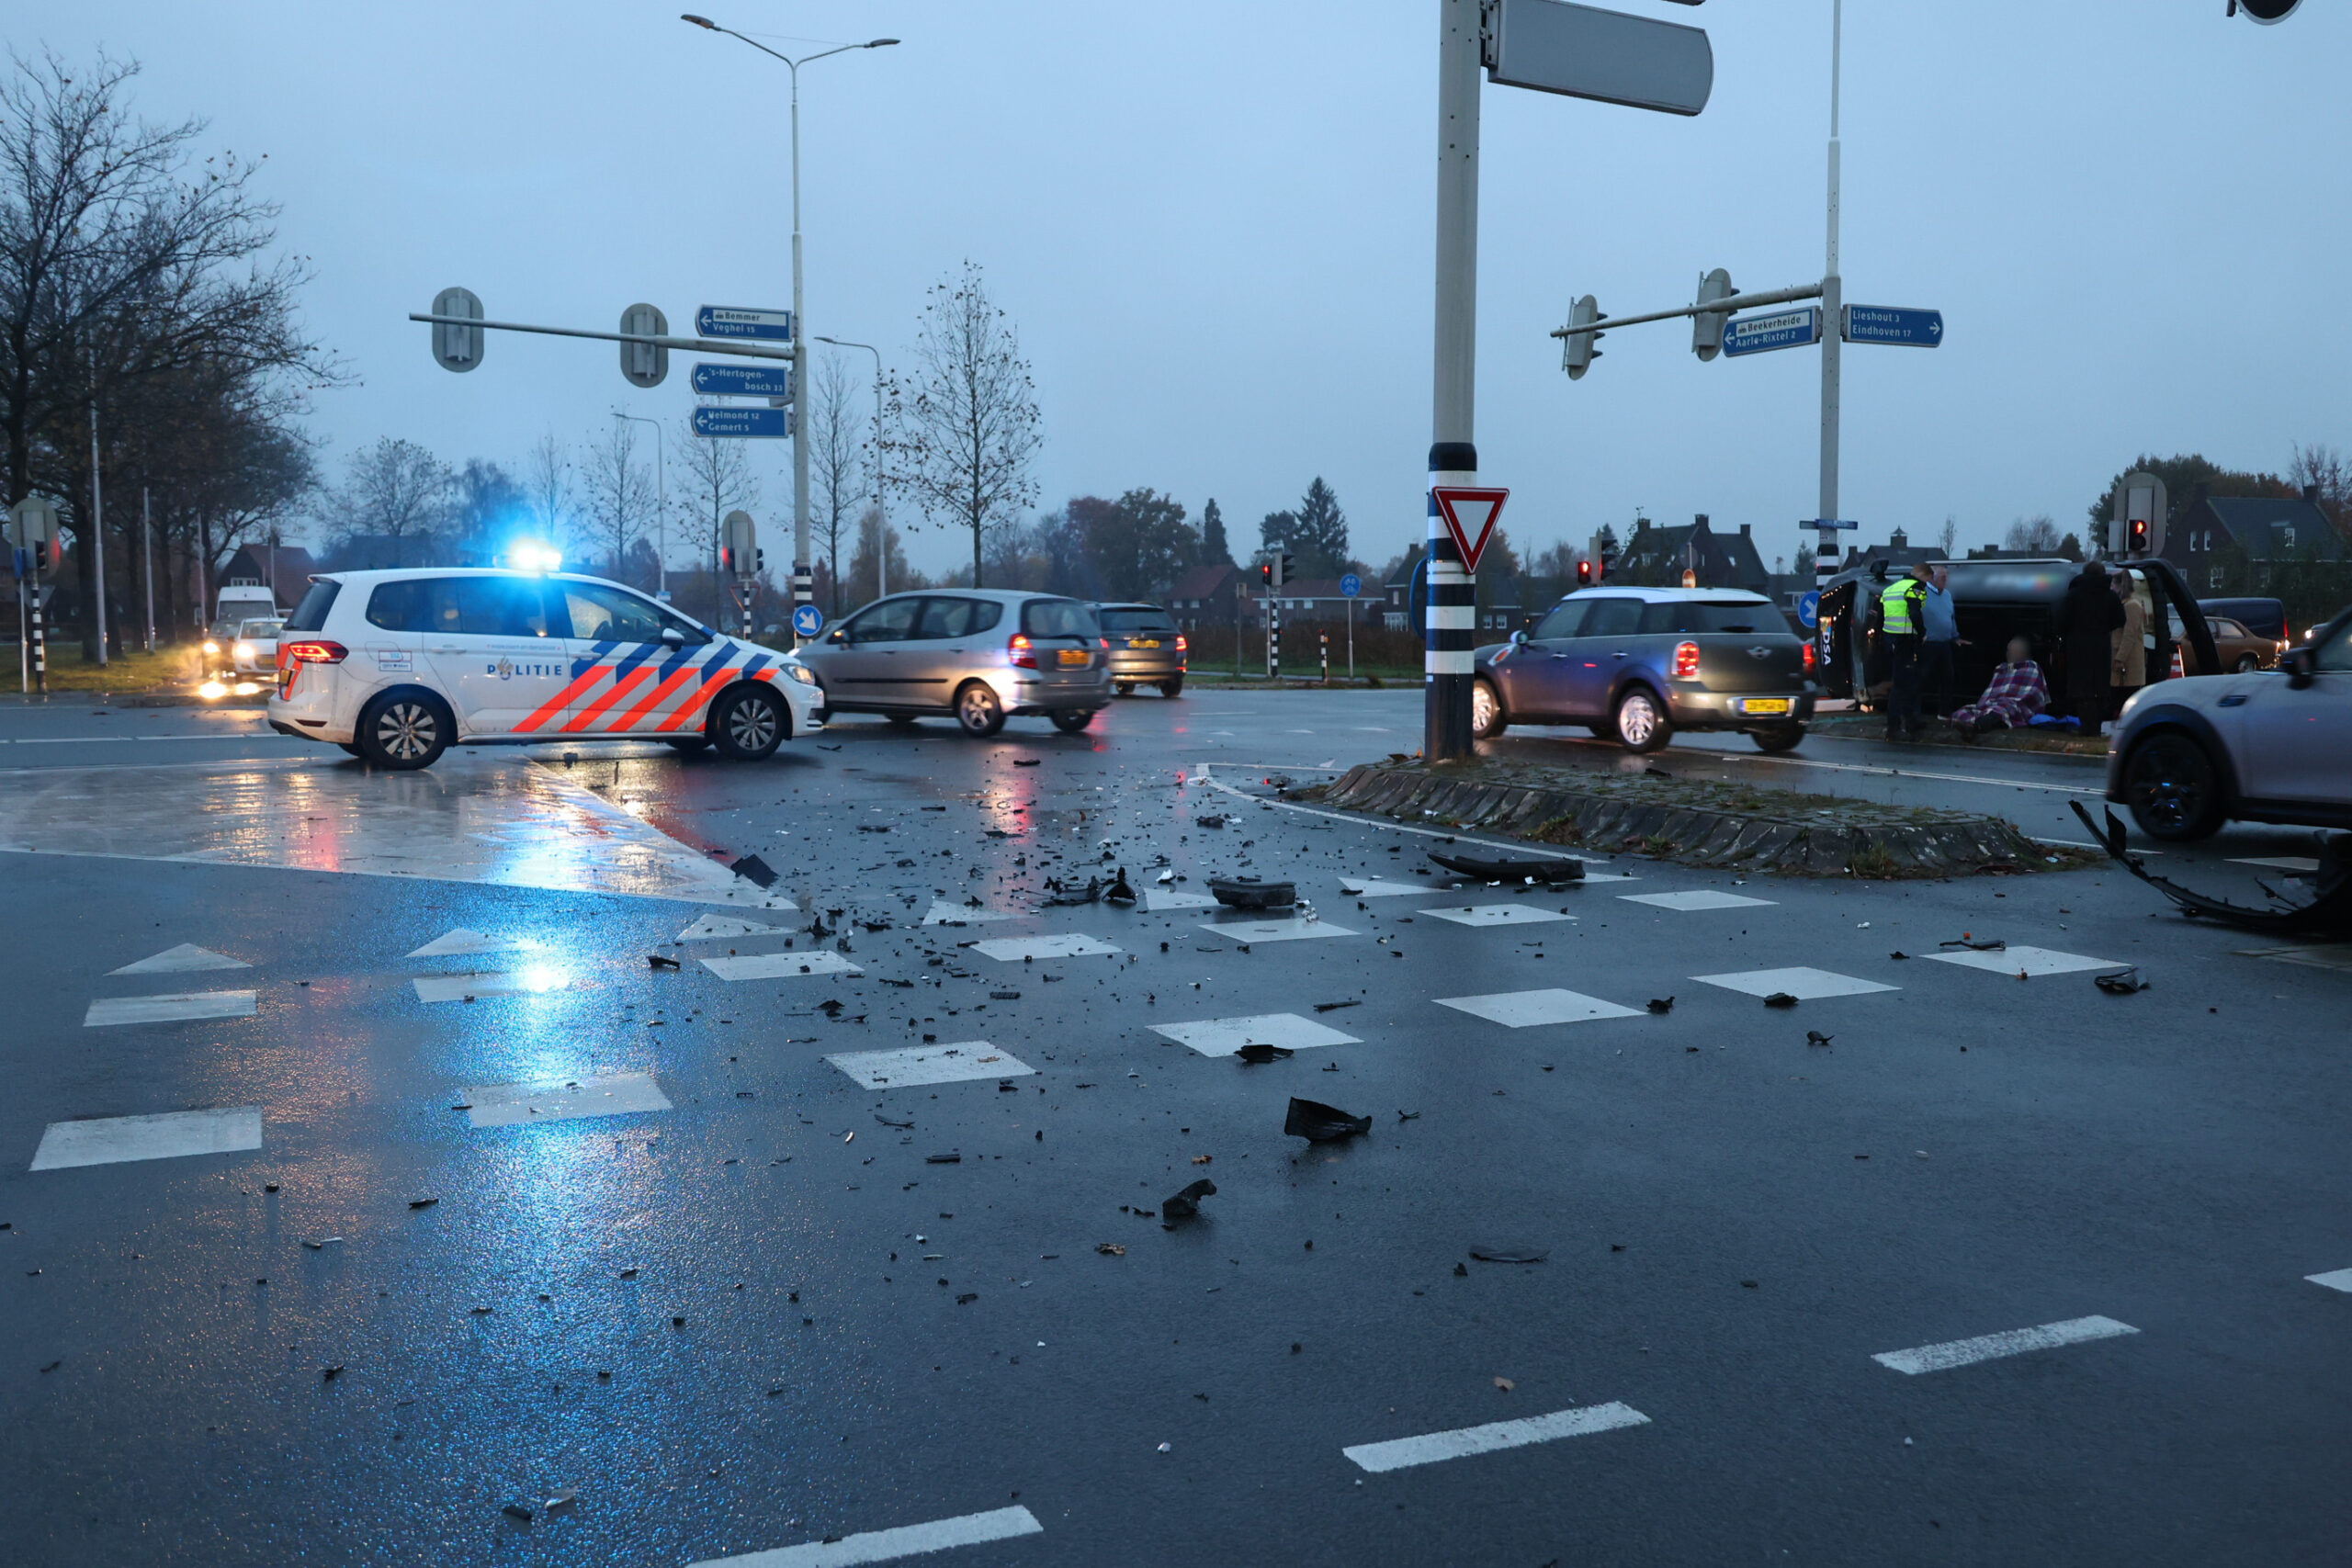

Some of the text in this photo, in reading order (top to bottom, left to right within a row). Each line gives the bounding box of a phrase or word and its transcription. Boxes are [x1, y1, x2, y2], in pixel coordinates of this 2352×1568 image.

[725, 312, 761, 321] Bemmer
[1852, 310, 1893, 322] Lieshout
[712, 322, 755, 333] Veghel 15
[1747, 315, 1802, 332] Beekerheide
[1852, 324, 1911, 337] Eindhoven 17
[1736, 331, 1796, 348] Aarle-Rixtel 2
[744, 382, 772, 391] bosch
[707, 422, 742, 432] Gemert
[1822, 632, 1832, 665] DSA
